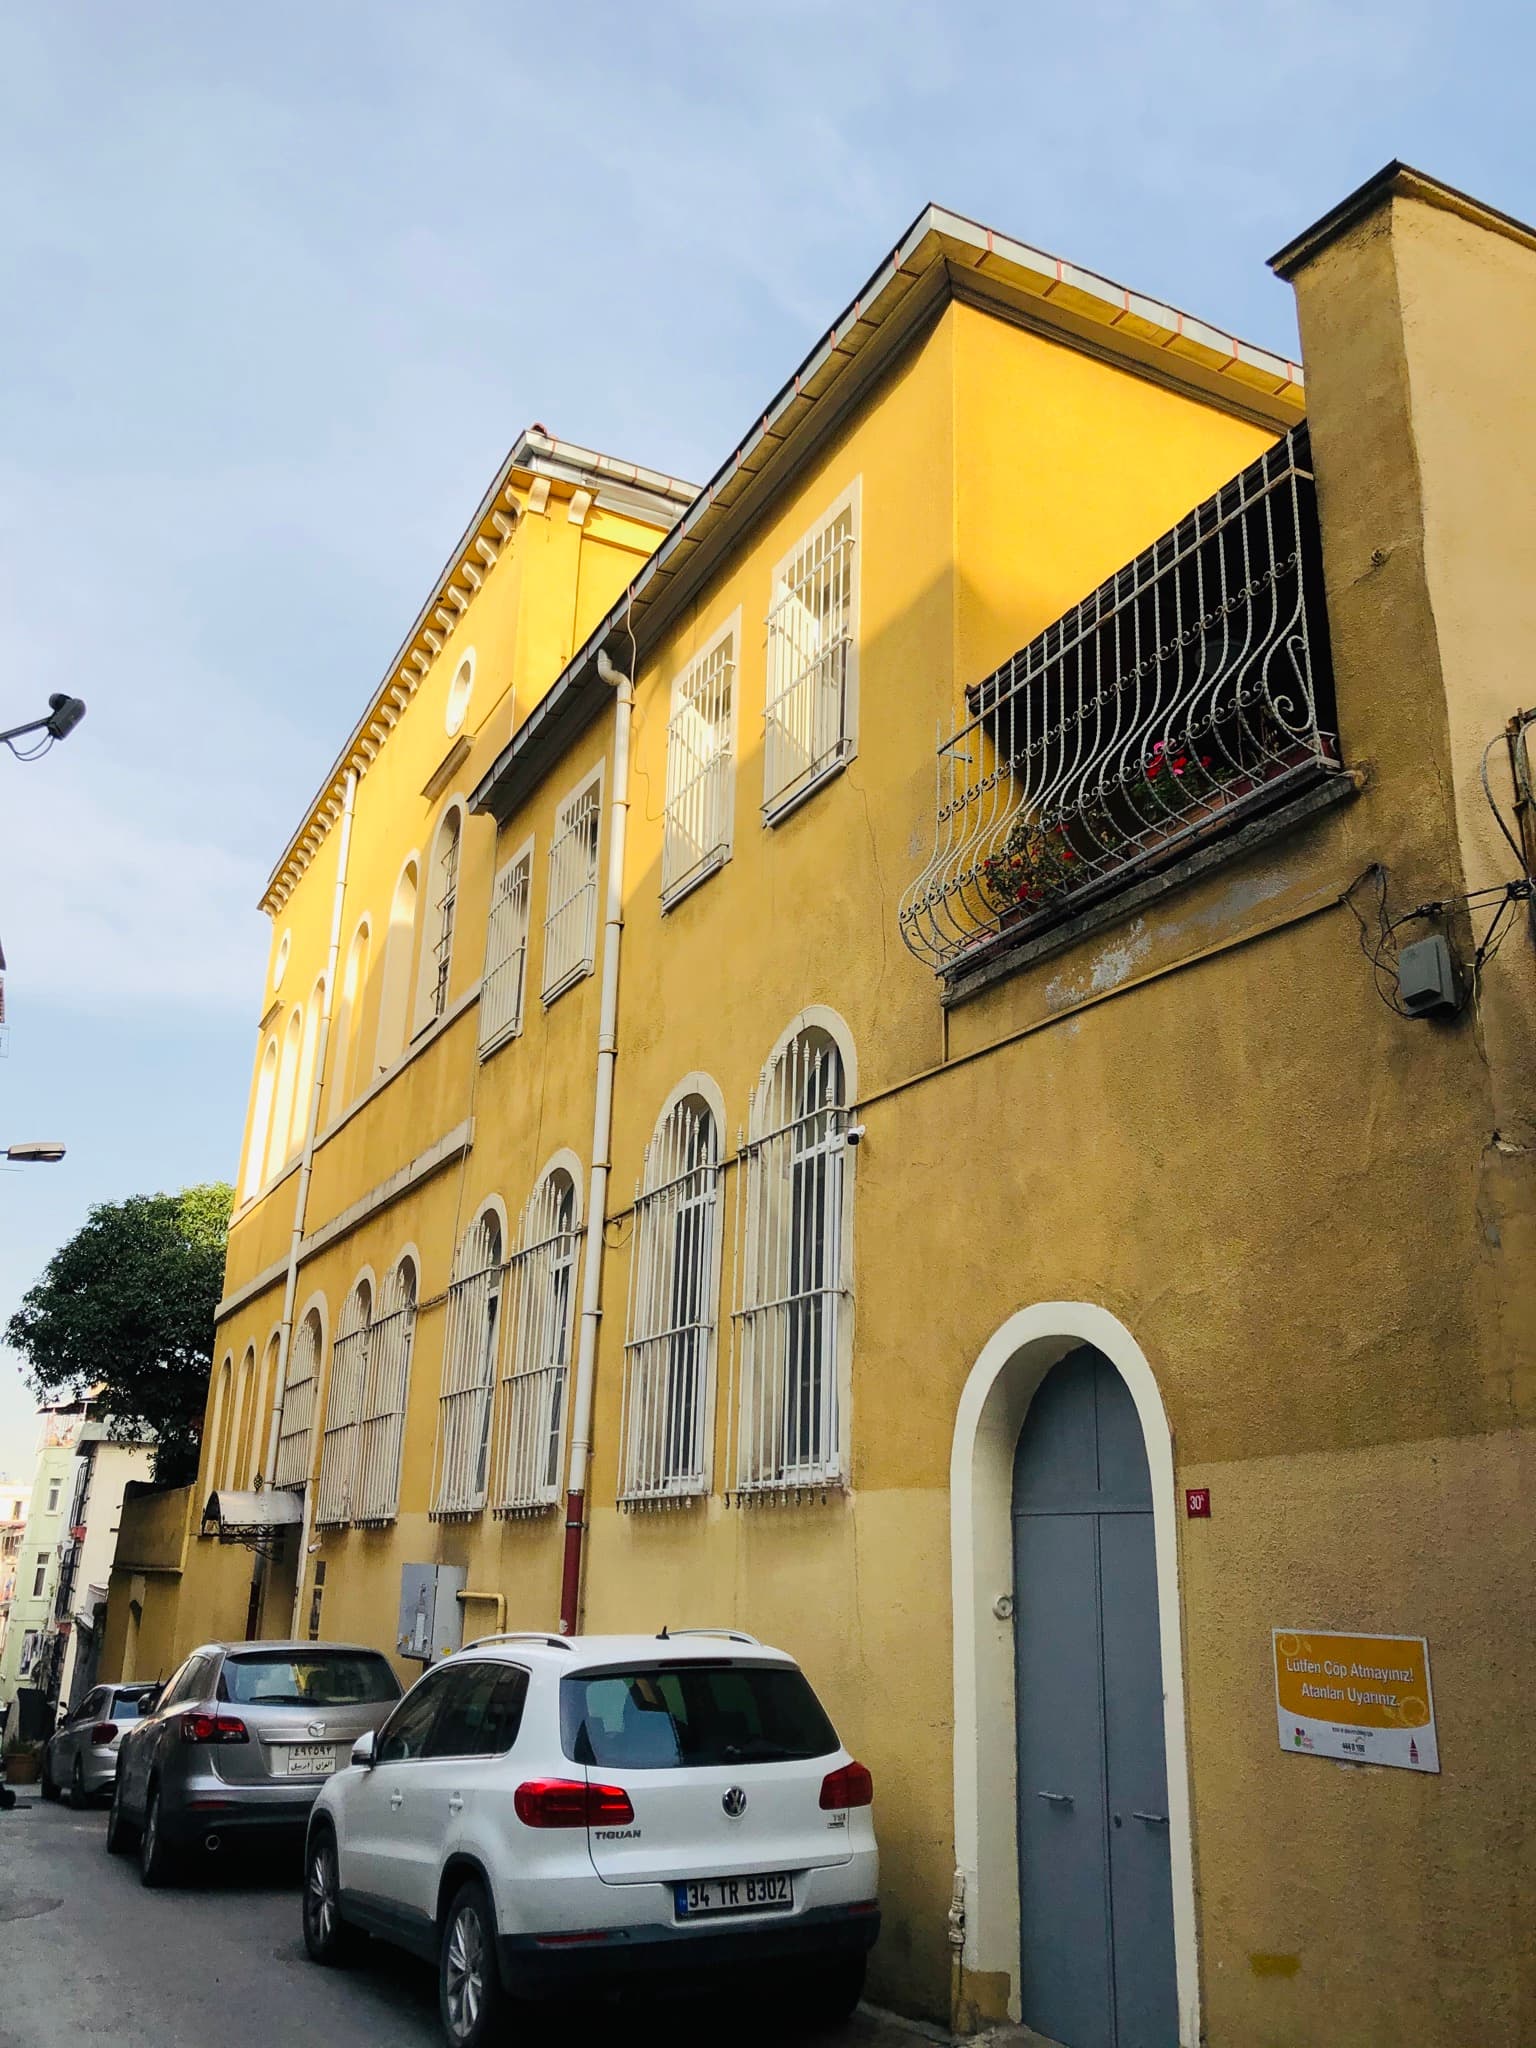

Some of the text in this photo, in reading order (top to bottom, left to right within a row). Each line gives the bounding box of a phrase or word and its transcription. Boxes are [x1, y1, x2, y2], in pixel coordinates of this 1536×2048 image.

[1286, 1657, 1321, 1674] Lütfen
[1324, 1660, 1348, 1679] Çöp
[594, 1829, 641, 1840] TIGUAN
[689, 1876, 788, 1909] 34 TR 8302
